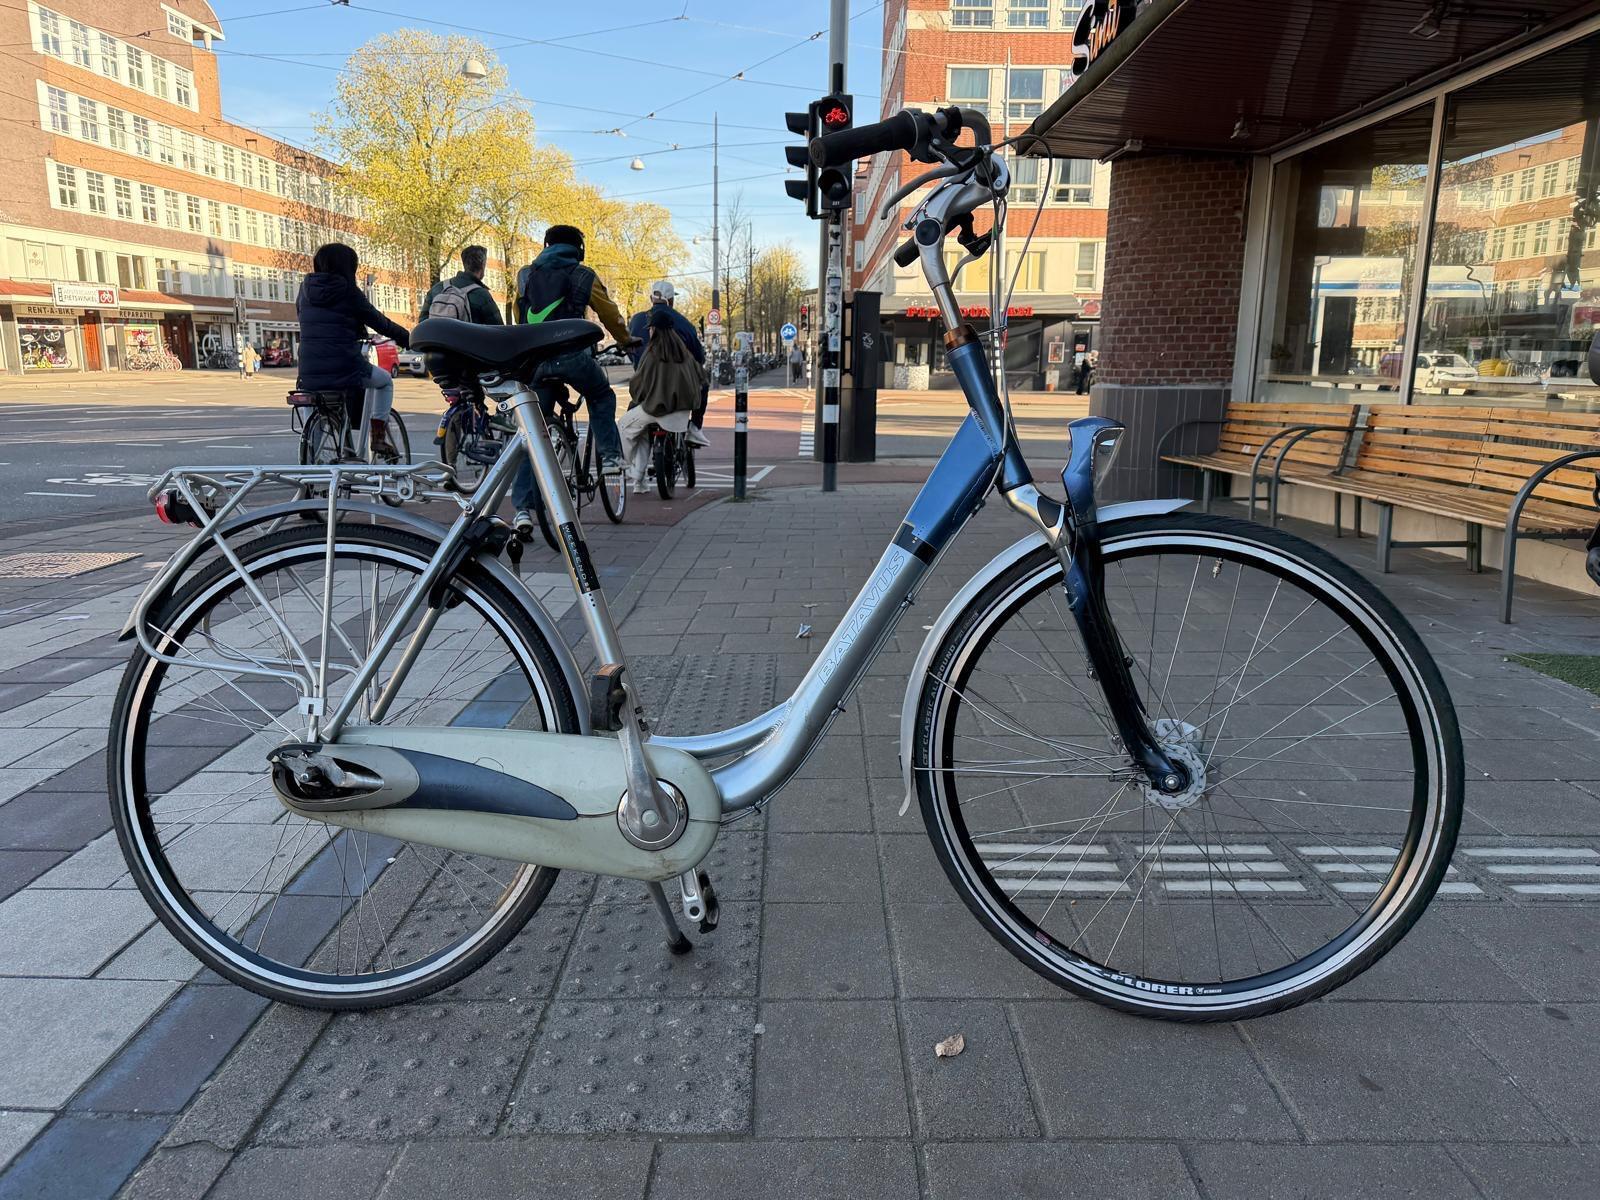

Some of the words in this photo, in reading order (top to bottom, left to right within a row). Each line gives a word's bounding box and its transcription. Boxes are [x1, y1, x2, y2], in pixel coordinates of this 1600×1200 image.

[27, 306, 75, 315] RENT-A-BIKE
[119, 310, 153, 319] REPARATIE
[563, 524, 587, 580] WEEKEND
[818, 550, 905, 685] BATAVUS
[923, 700, 935, 745] CLASSIC
[1068, 958, 1194, 996] X-PLORER
